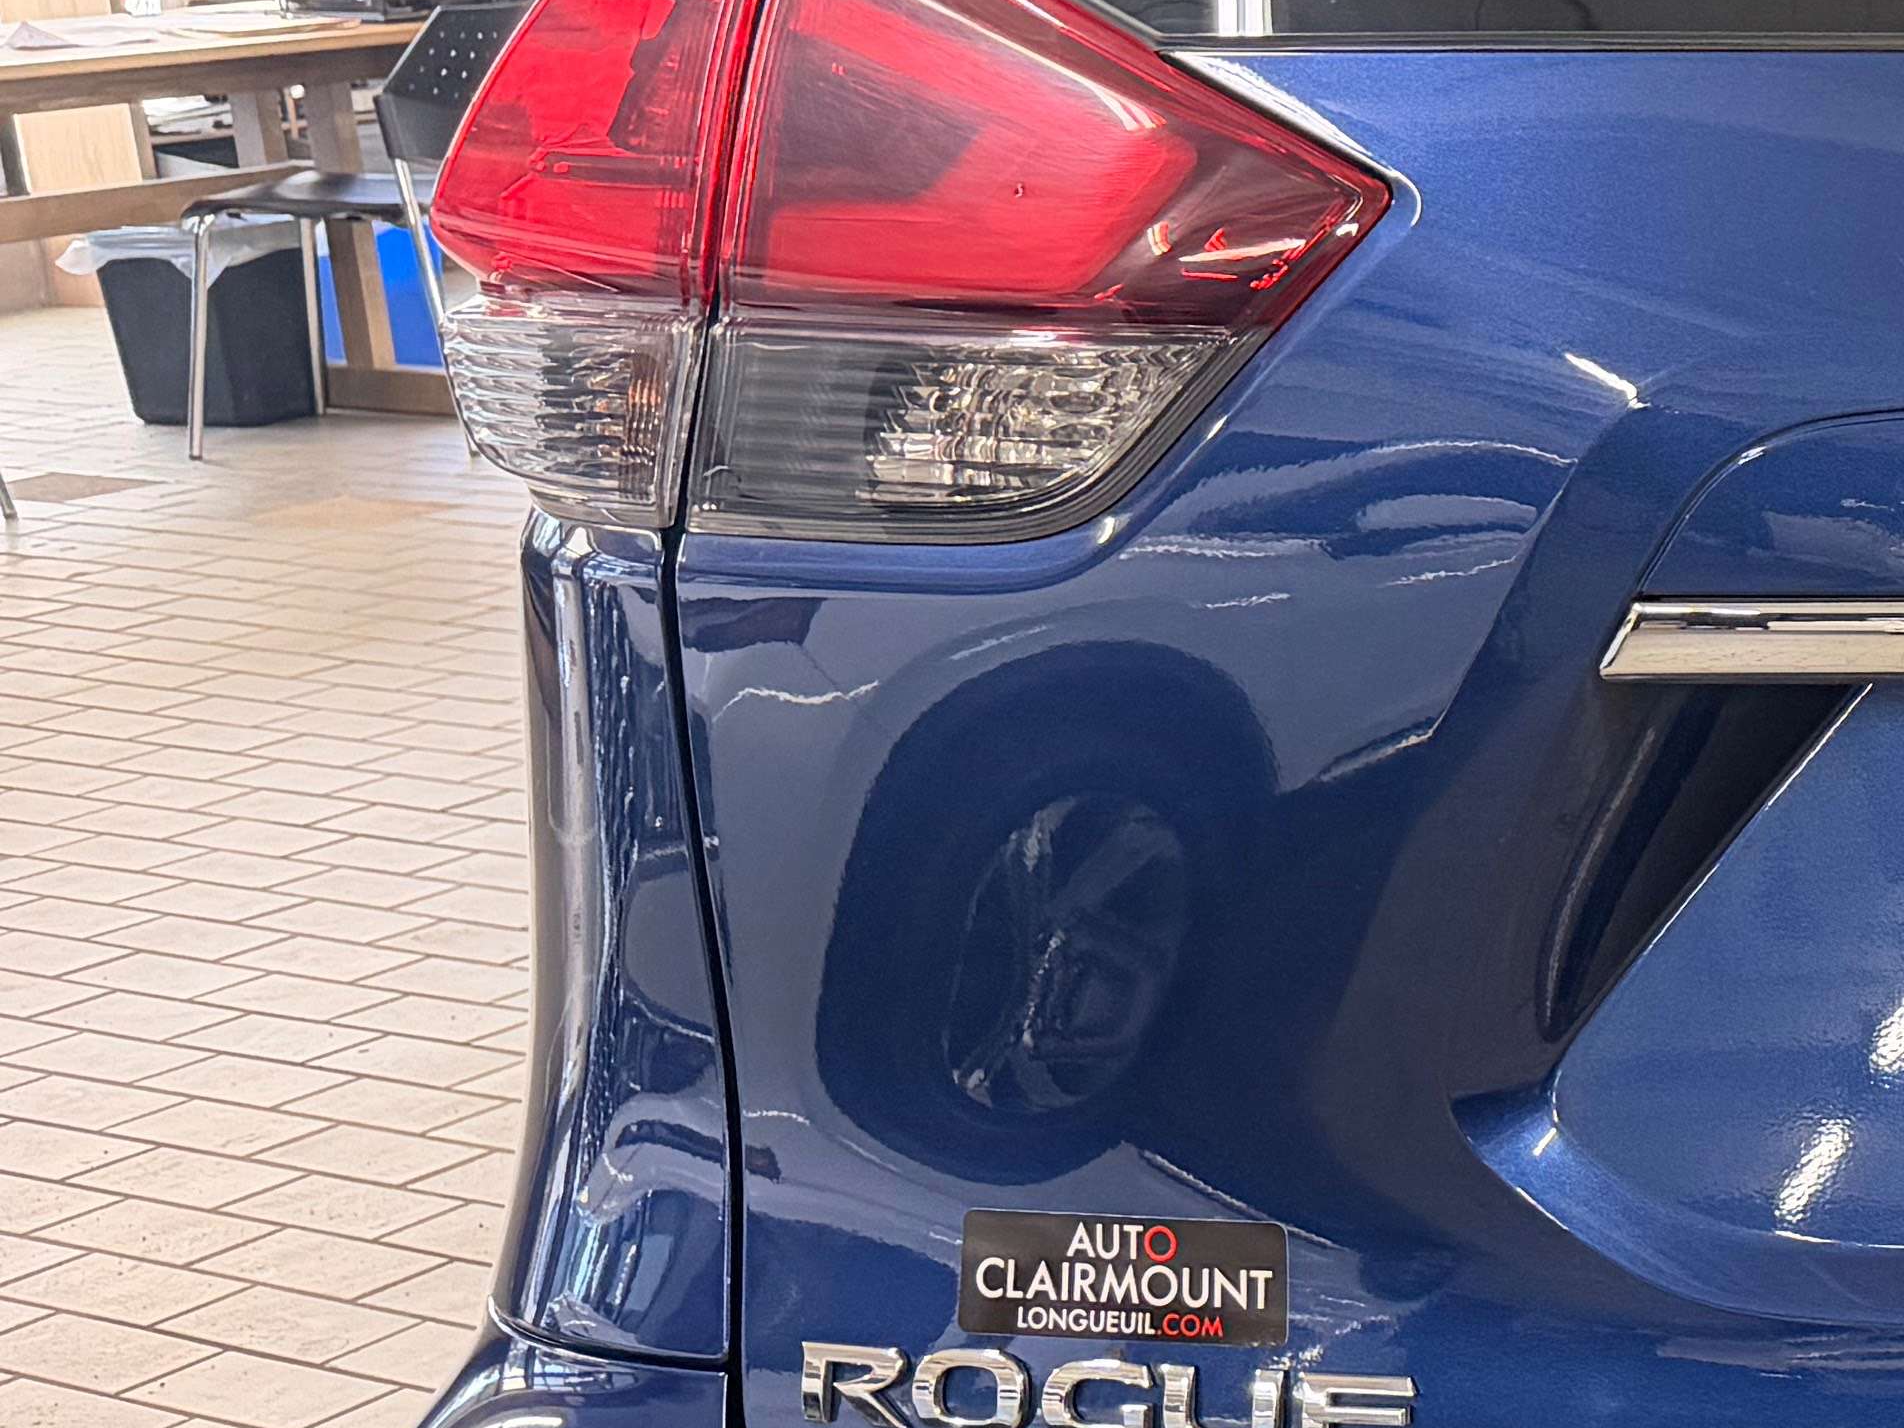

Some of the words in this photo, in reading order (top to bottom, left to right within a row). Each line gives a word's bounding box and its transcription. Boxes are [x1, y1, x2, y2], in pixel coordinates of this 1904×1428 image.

[1066, 1222, 1178, 1263] AUTO
[975, 1257, 1273, 1311] CLAIRMOUNT
[1016, 1306, 1224, 1338] LONGUEUIL.COM
